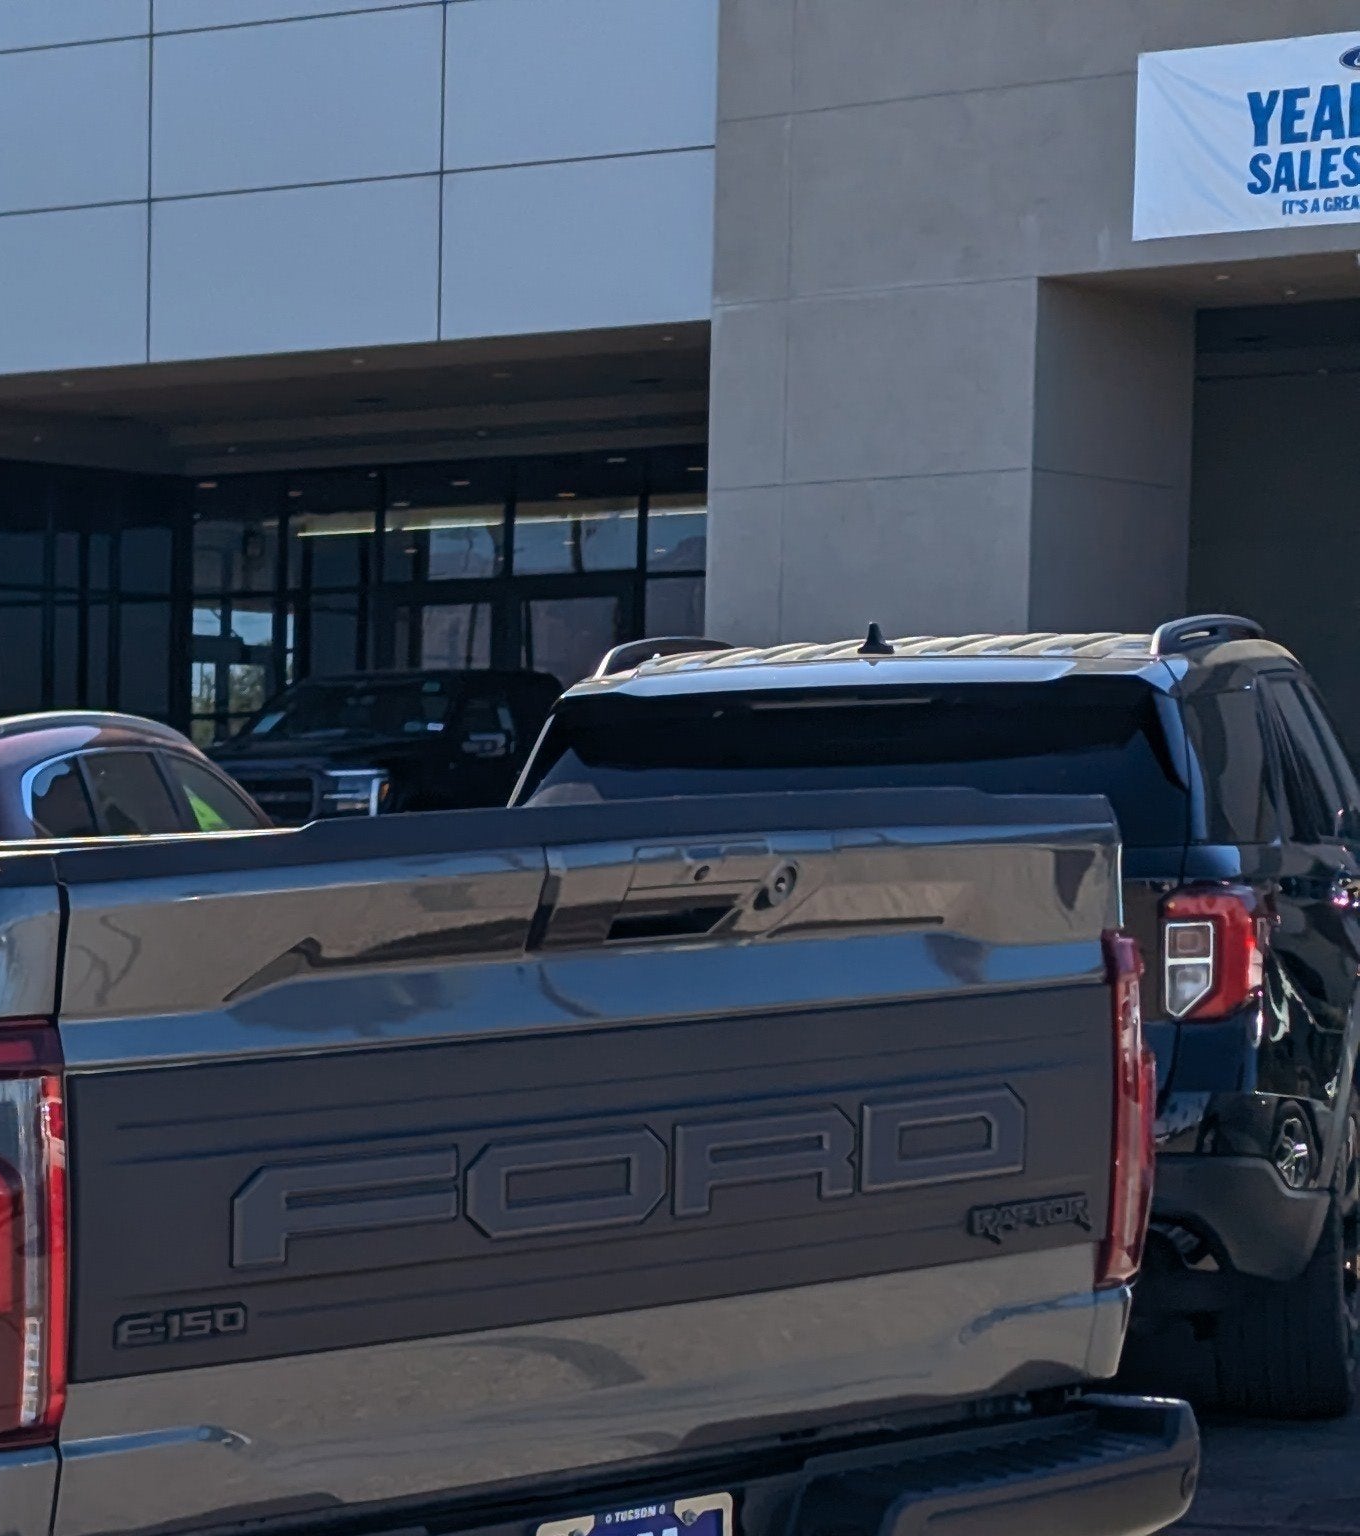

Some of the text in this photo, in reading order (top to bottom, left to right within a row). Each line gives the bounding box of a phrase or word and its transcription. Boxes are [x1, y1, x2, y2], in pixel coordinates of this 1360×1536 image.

[1246, 145, 1360, 195] SALES
[1282, 199, 1308, 215] IT'S
[1311, 198, 1320, 213] A
[230, 1083, 1027, 1269] FORD
[968, 1193, 1094, 1242] RAPTOR
[614, 1505, 657, 1523] TUCSON
